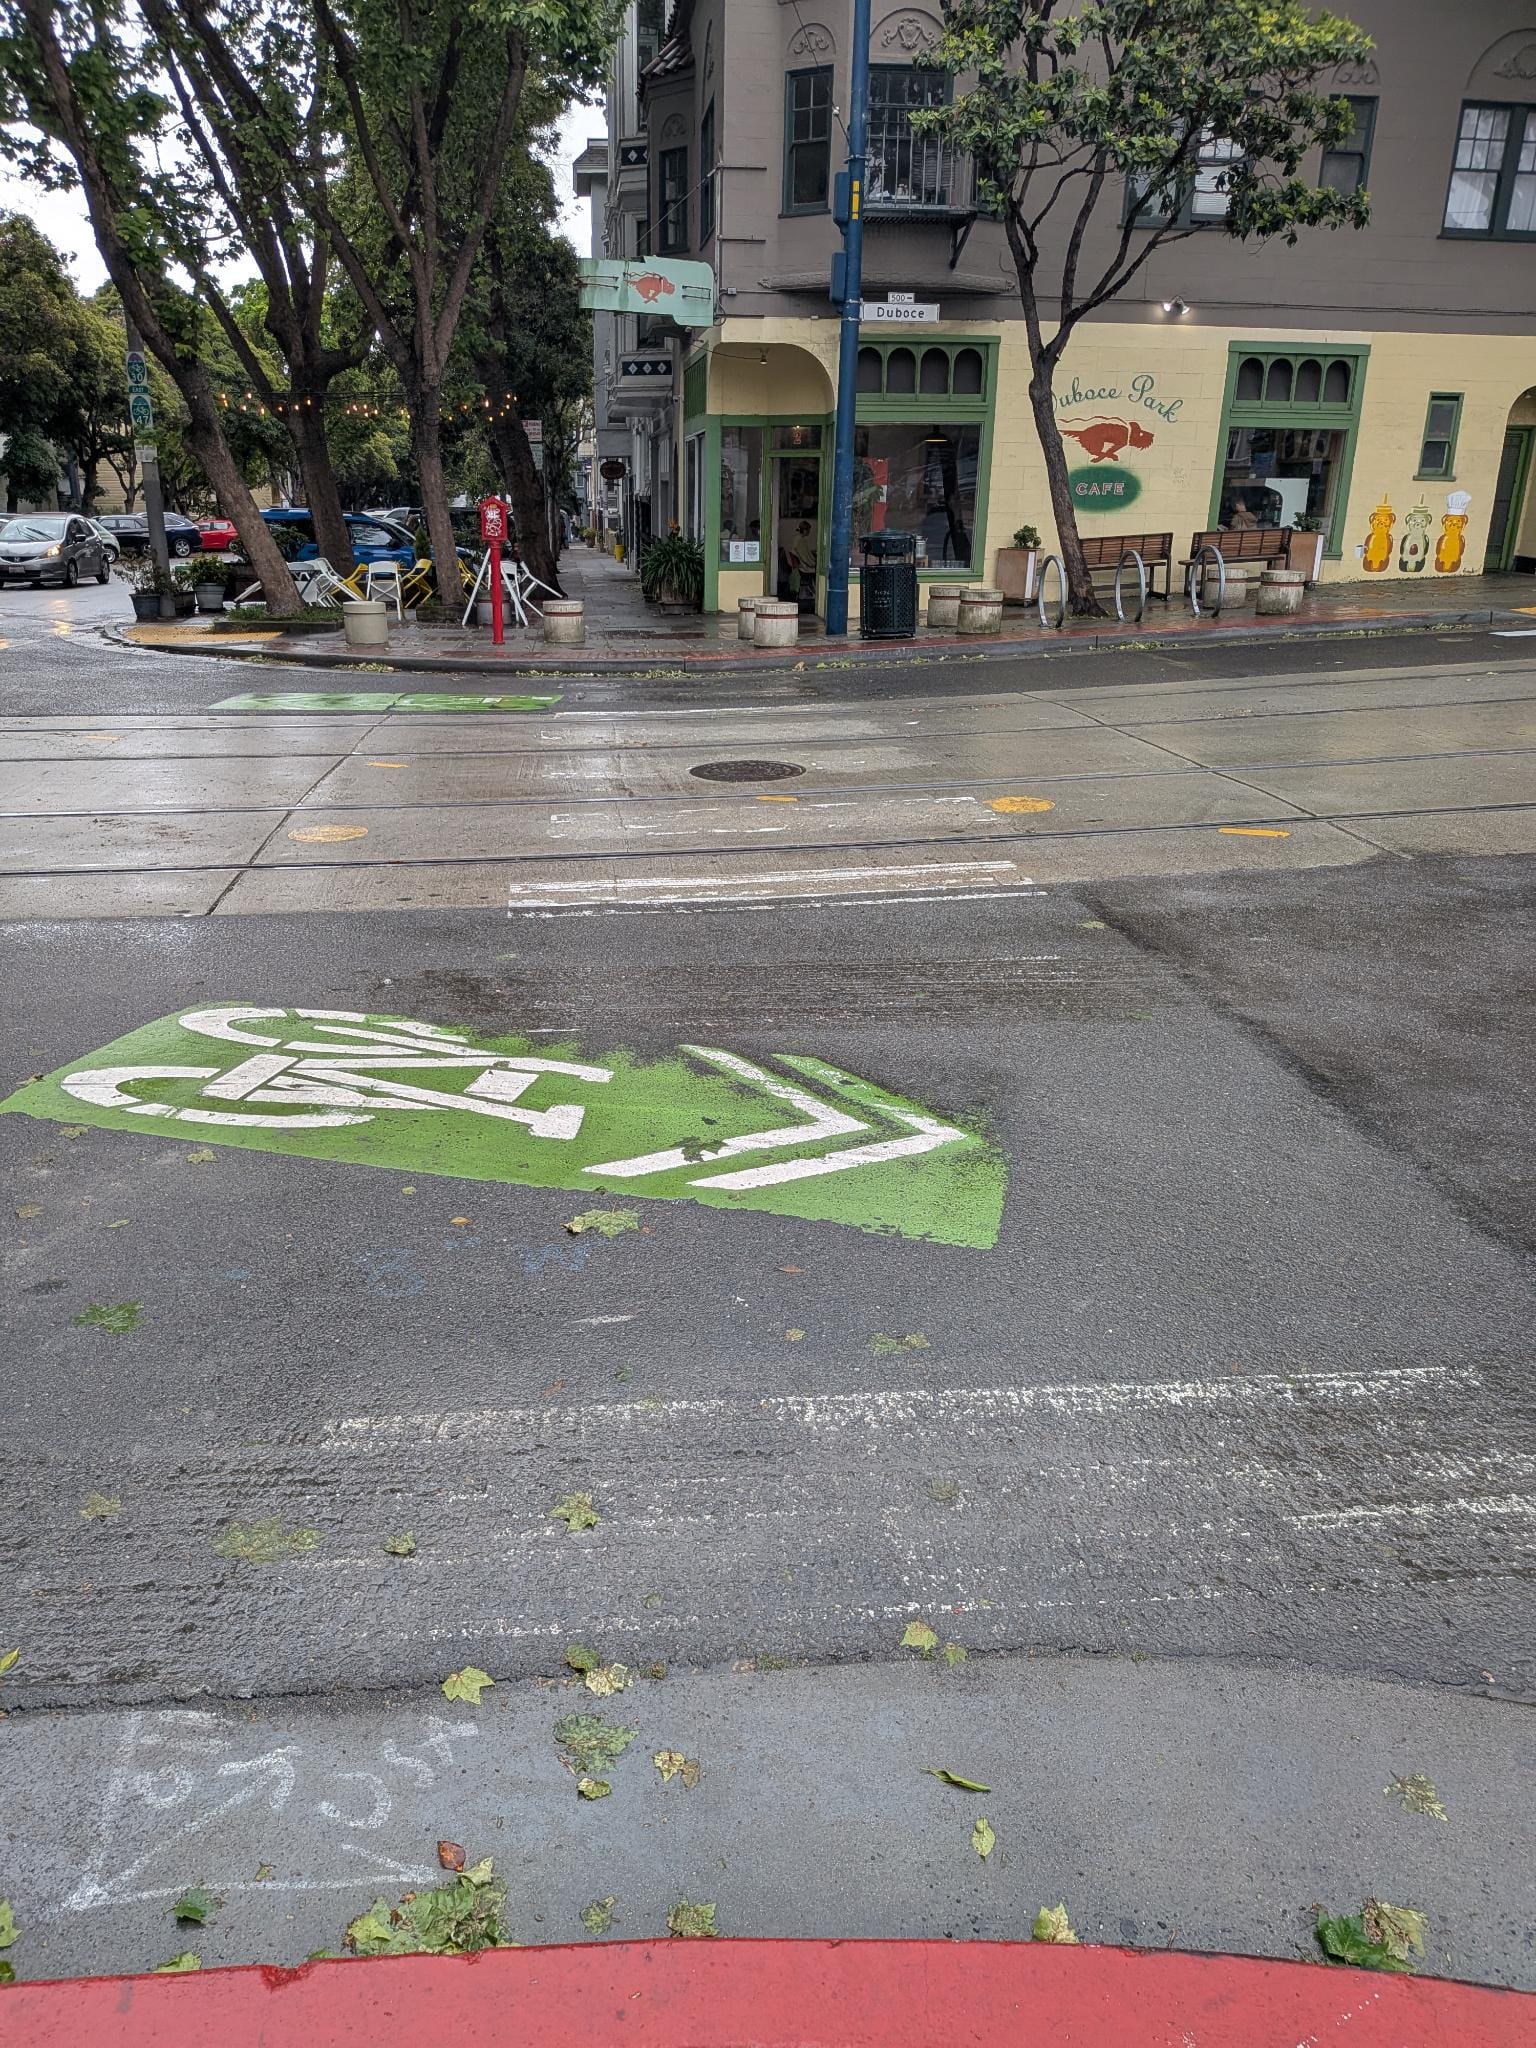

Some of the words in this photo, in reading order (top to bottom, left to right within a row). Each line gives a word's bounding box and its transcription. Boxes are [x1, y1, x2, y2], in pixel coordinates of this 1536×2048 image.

[891, 294, 906, 302] 500
[877, 307, 925, 319] Duboce
[131, 373, 144, 382] 30
[1128, 374, 1184, 424] Park
[136, 415, 149, 425] 47
[1075, 482, 1125, 496] CAFE
